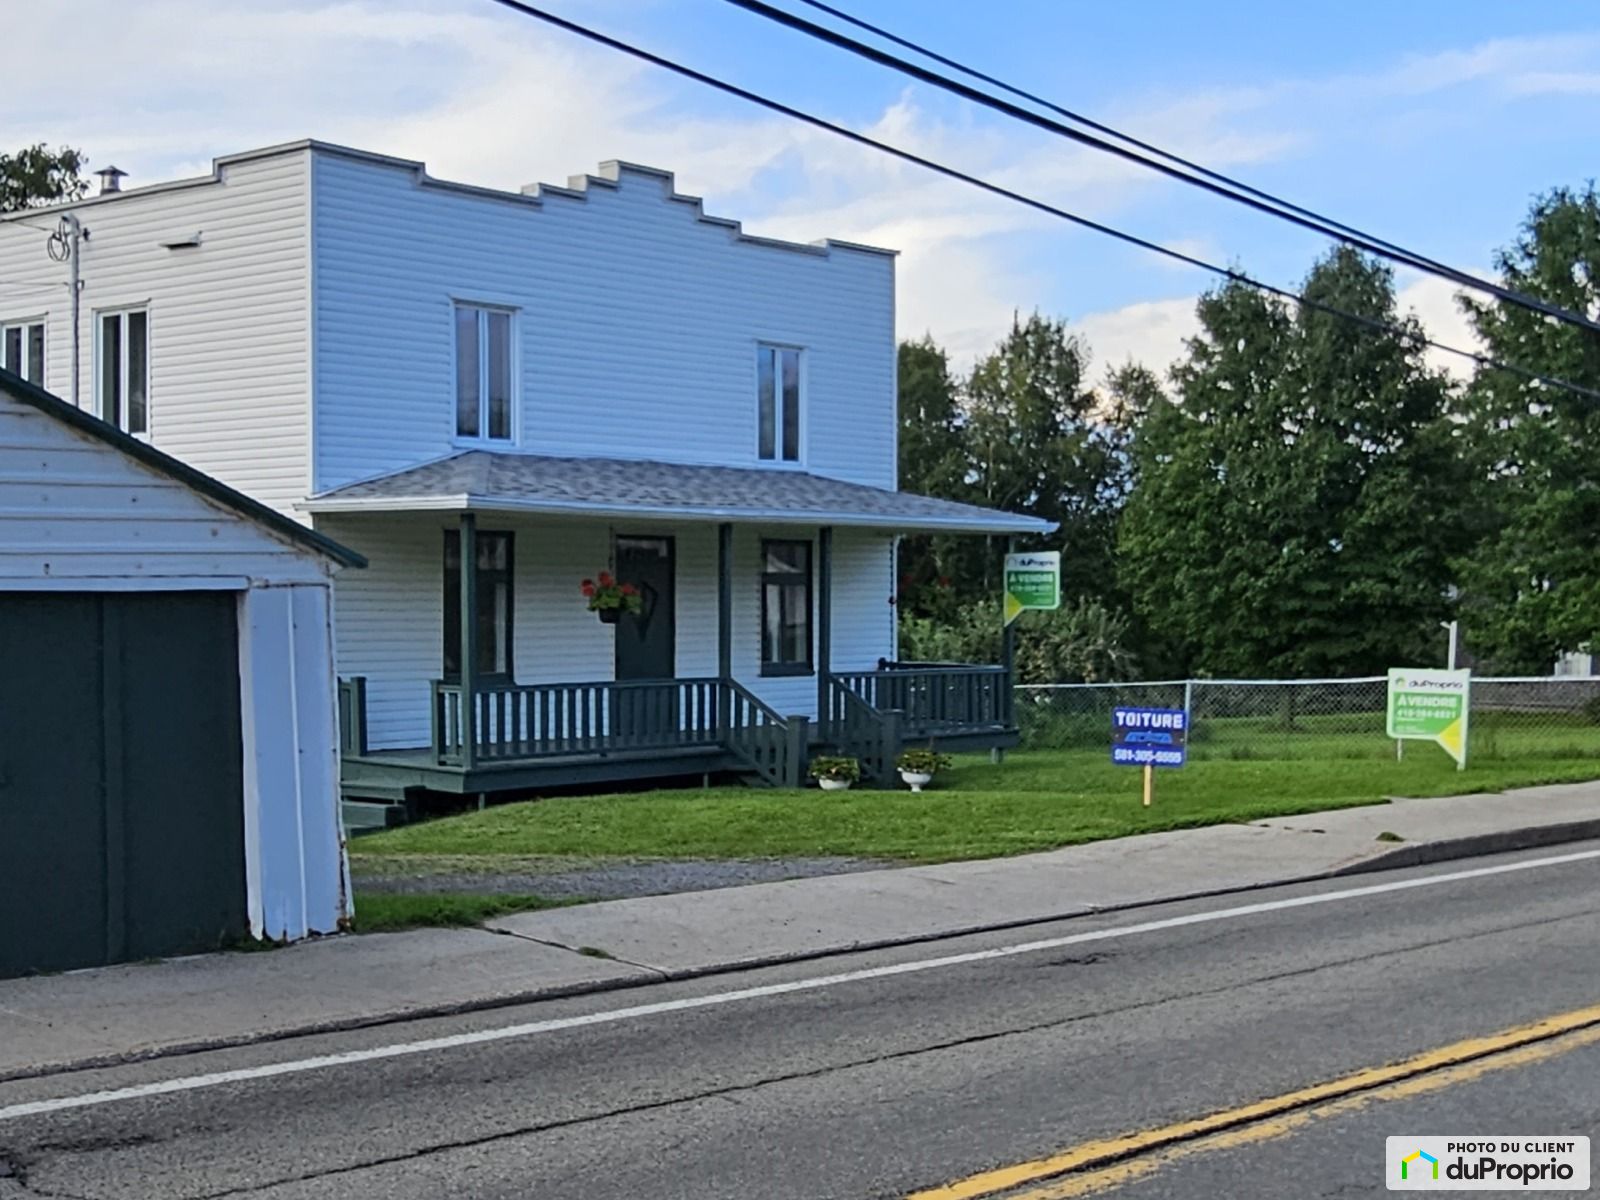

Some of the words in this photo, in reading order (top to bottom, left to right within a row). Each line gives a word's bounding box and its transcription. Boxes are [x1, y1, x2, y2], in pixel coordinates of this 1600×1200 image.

[1409, 680, 1463, 690] duProprio
[1407, 696, 1457, 708] VENDRE
[1115, 711, 1183, 729] TOITURE
